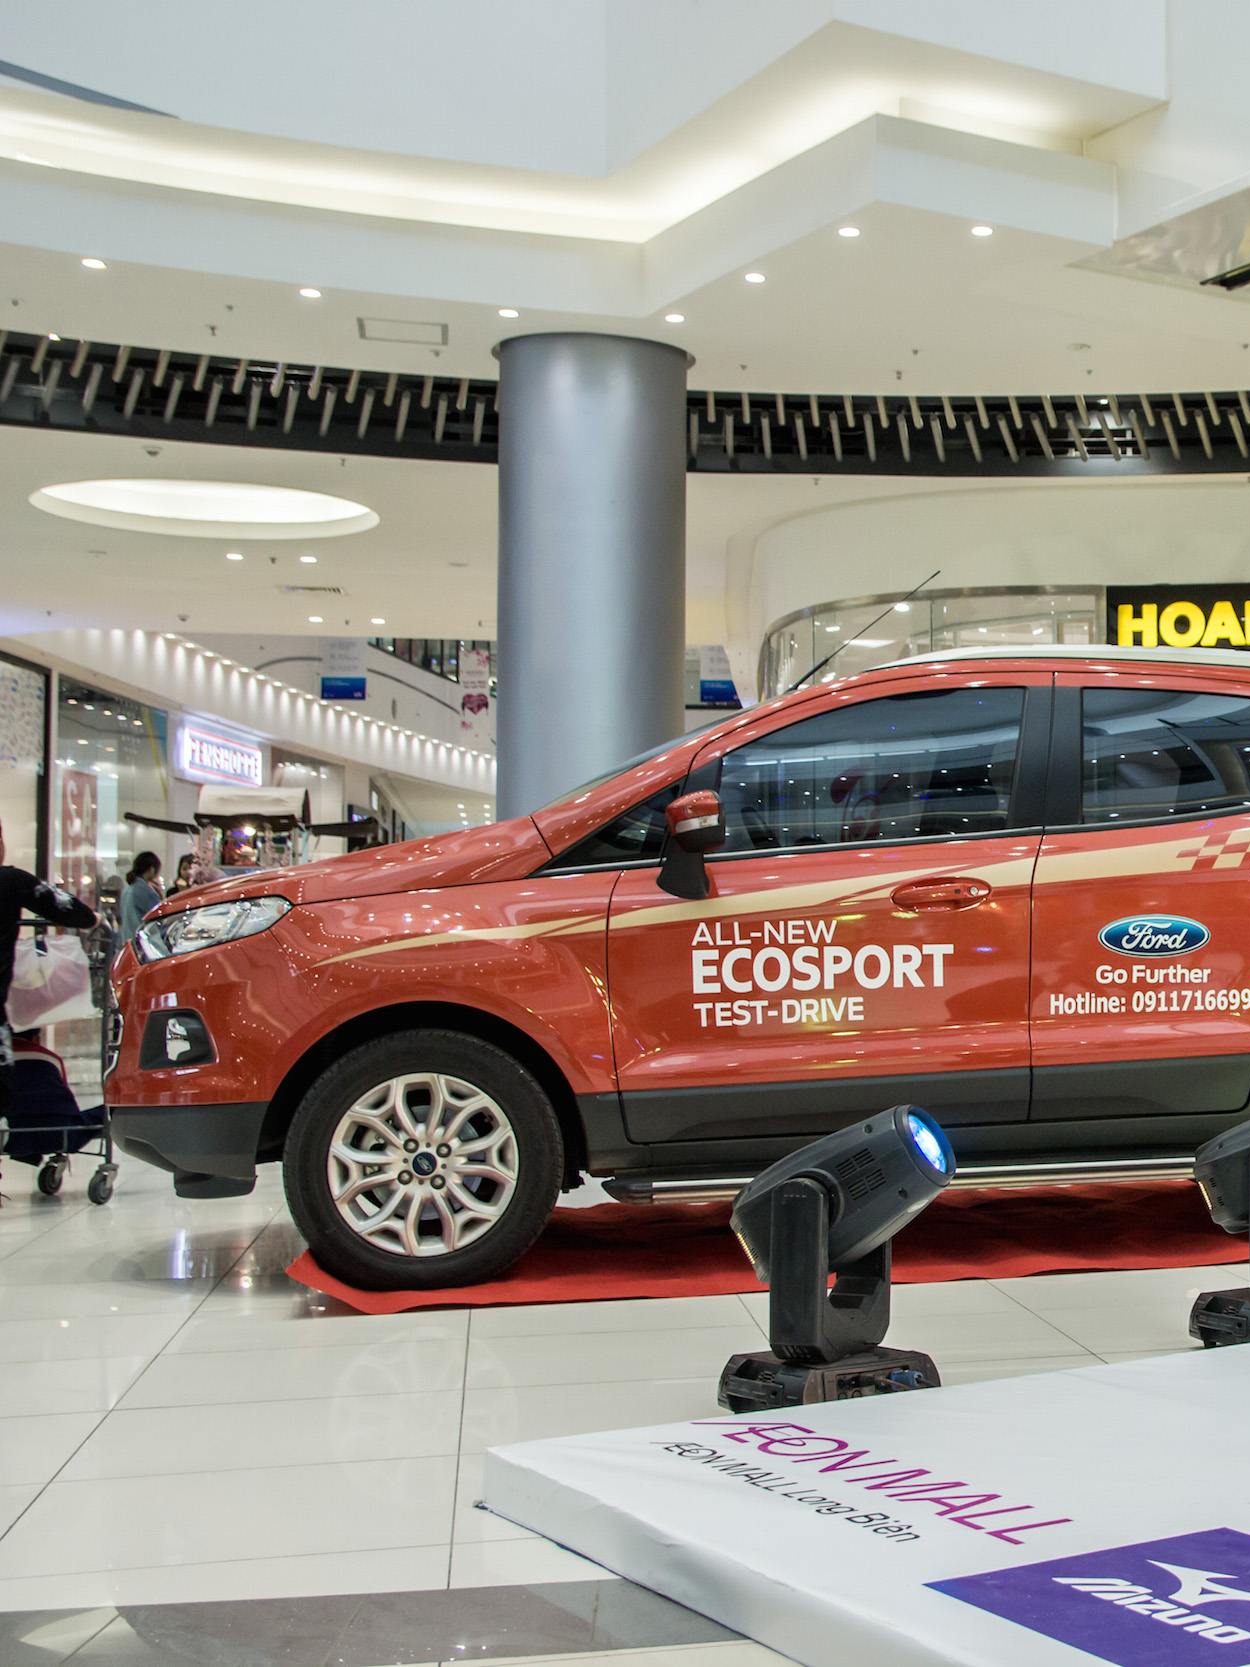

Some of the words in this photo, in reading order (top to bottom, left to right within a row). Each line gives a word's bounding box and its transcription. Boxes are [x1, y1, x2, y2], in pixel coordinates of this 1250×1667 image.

[691, 920, 838, 946] ALL-NEW
[1121, 921, 1189, 950] Ford
[691, 943, 954, 994] ECOSPORT
[1095, 965, 1129, 984] Go
[1132, 964, 1212, 984] Further
[693, 996, 865, 1027] TEST-DRIVE
[1050, 991, 1127, 1015] Hotline:
[711, 1462, 799, 1491] MALL
[780, 1488, 860, 1515] Long
[844, 1512, 922, 1543] Biên
[843, 1468, 1074, 1545] MALL
